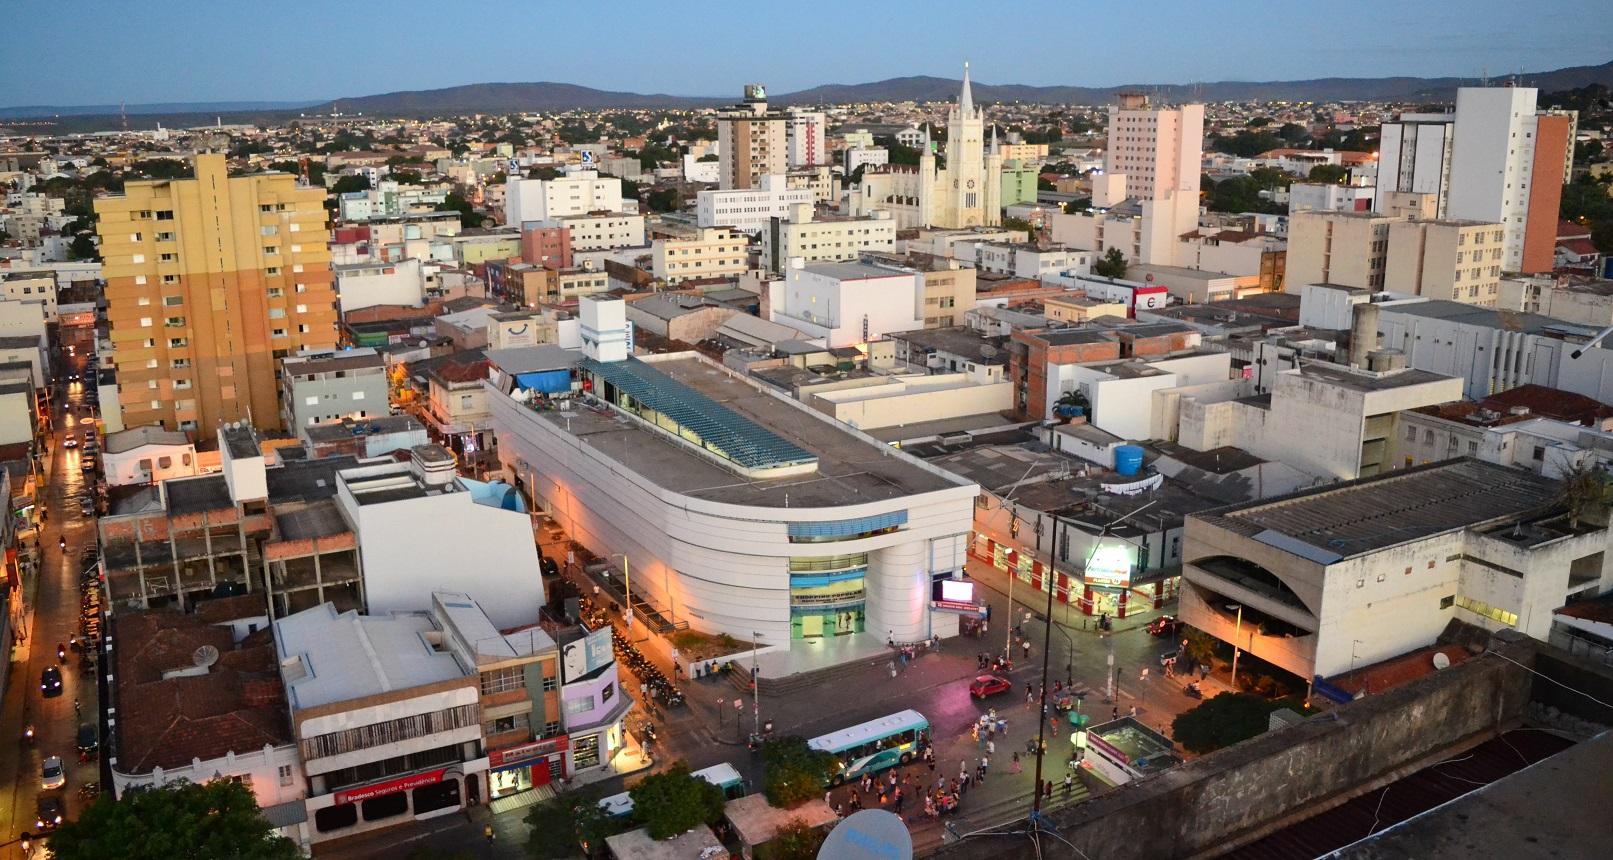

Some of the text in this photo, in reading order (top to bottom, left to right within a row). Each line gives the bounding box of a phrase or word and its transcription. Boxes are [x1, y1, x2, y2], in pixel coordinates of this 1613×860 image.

[347, 791, 375, 802] Bradesco
[375, 786, 398, 795] Seguros
[404, 777, 436, 788] Previdência
